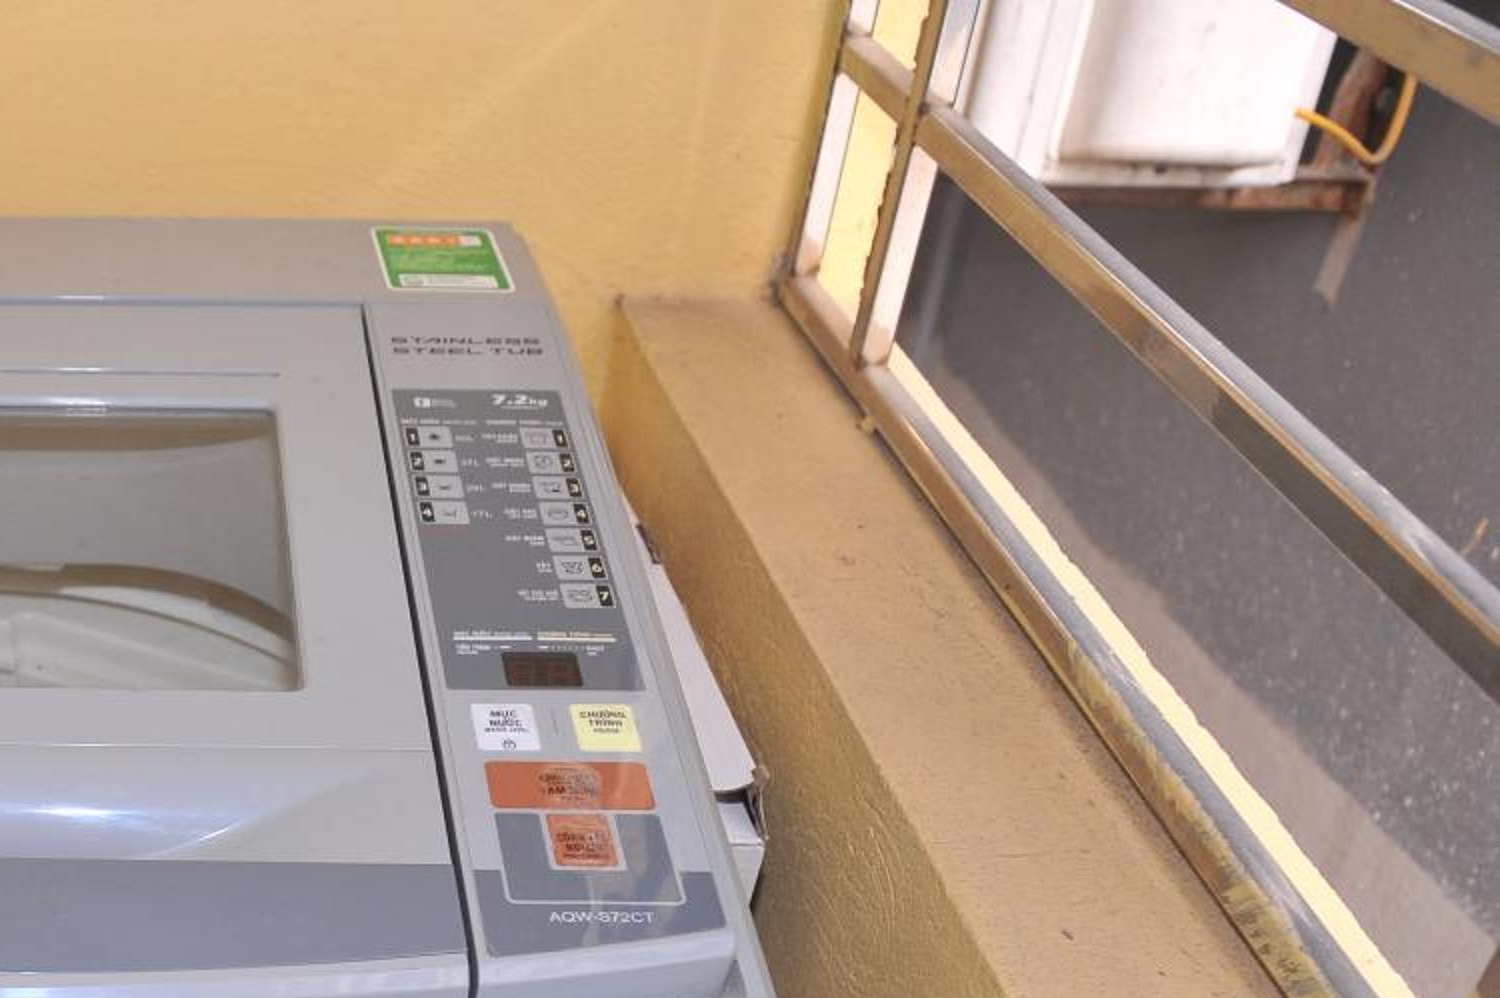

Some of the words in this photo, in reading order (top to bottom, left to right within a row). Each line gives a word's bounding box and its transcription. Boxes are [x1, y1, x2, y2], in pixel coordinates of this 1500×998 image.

[391, 336, 540, 345] STAINLESS
[393, 346, 483, 355] STEEL
[490, 346, 543, 355] TUB
